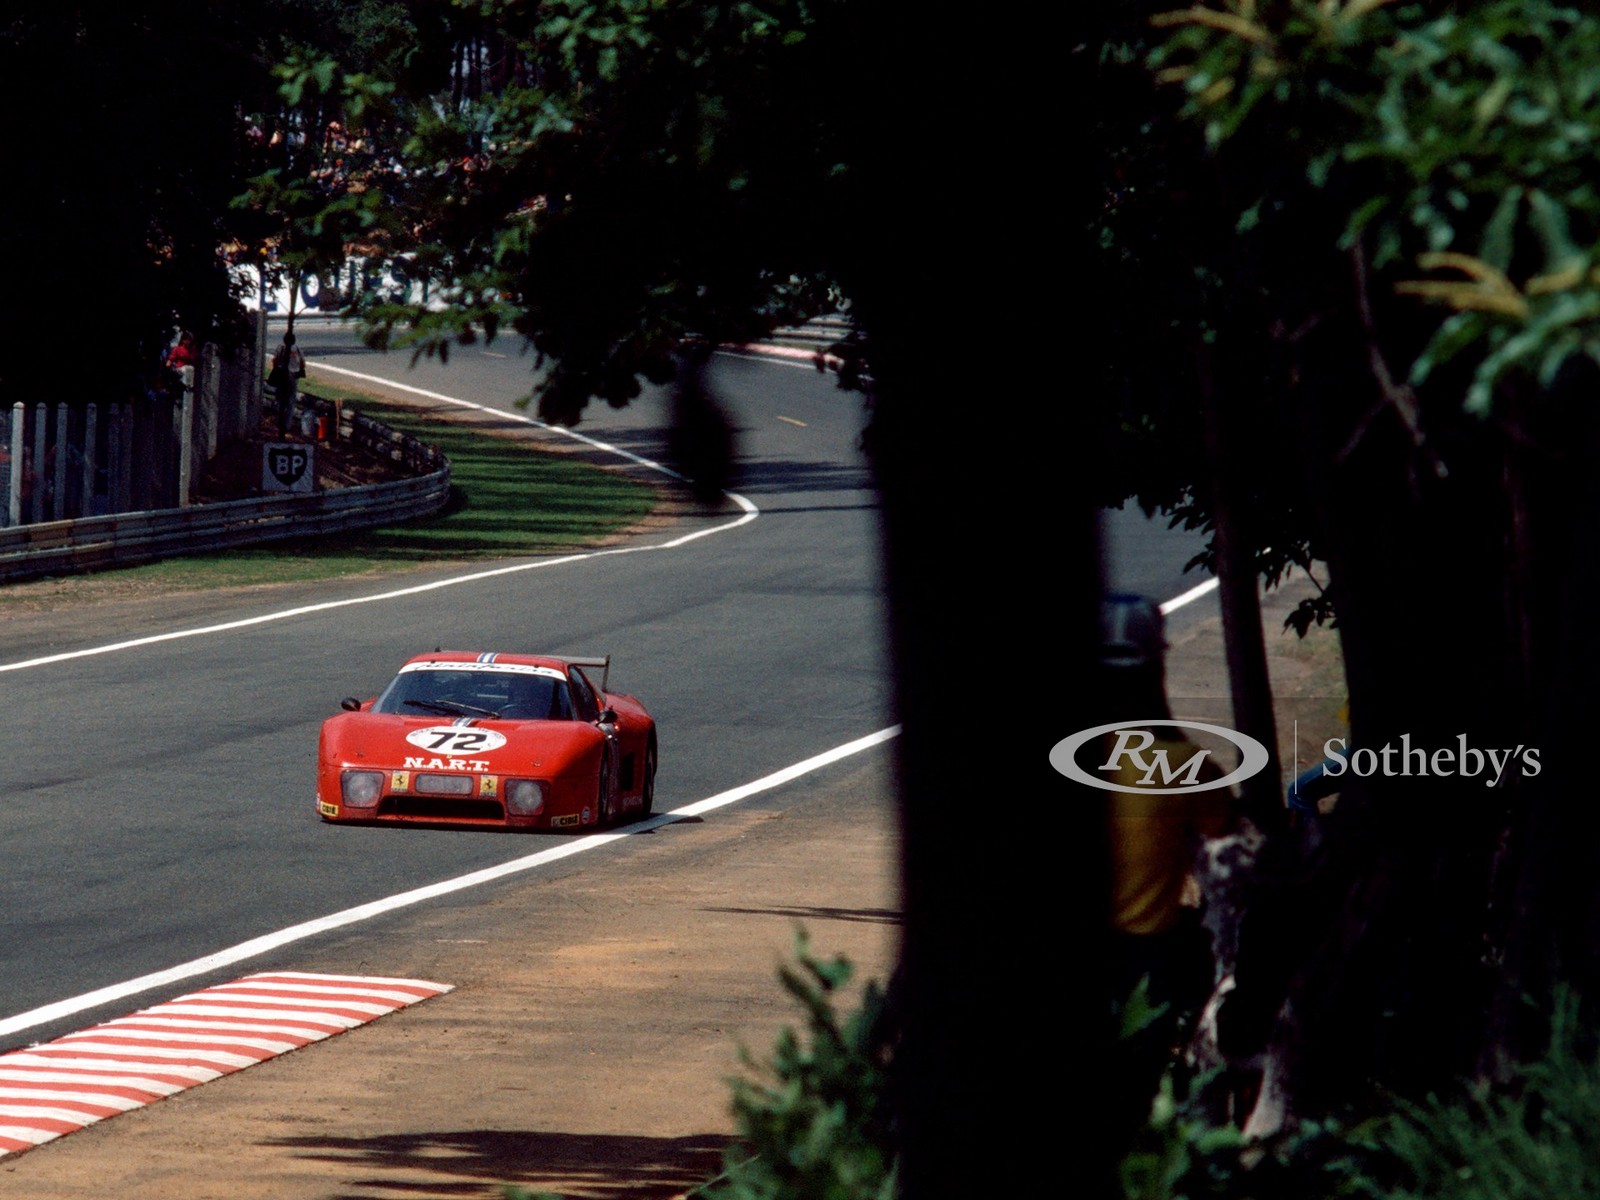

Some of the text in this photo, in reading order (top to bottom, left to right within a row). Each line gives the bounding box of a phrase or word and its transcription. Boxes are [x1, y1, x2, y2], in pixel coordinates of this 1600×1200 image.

[275, 454, 304, 475] BP
[427, 732, 487, 751] 72
[403, 757, 490, 772] N.A.R.T.
